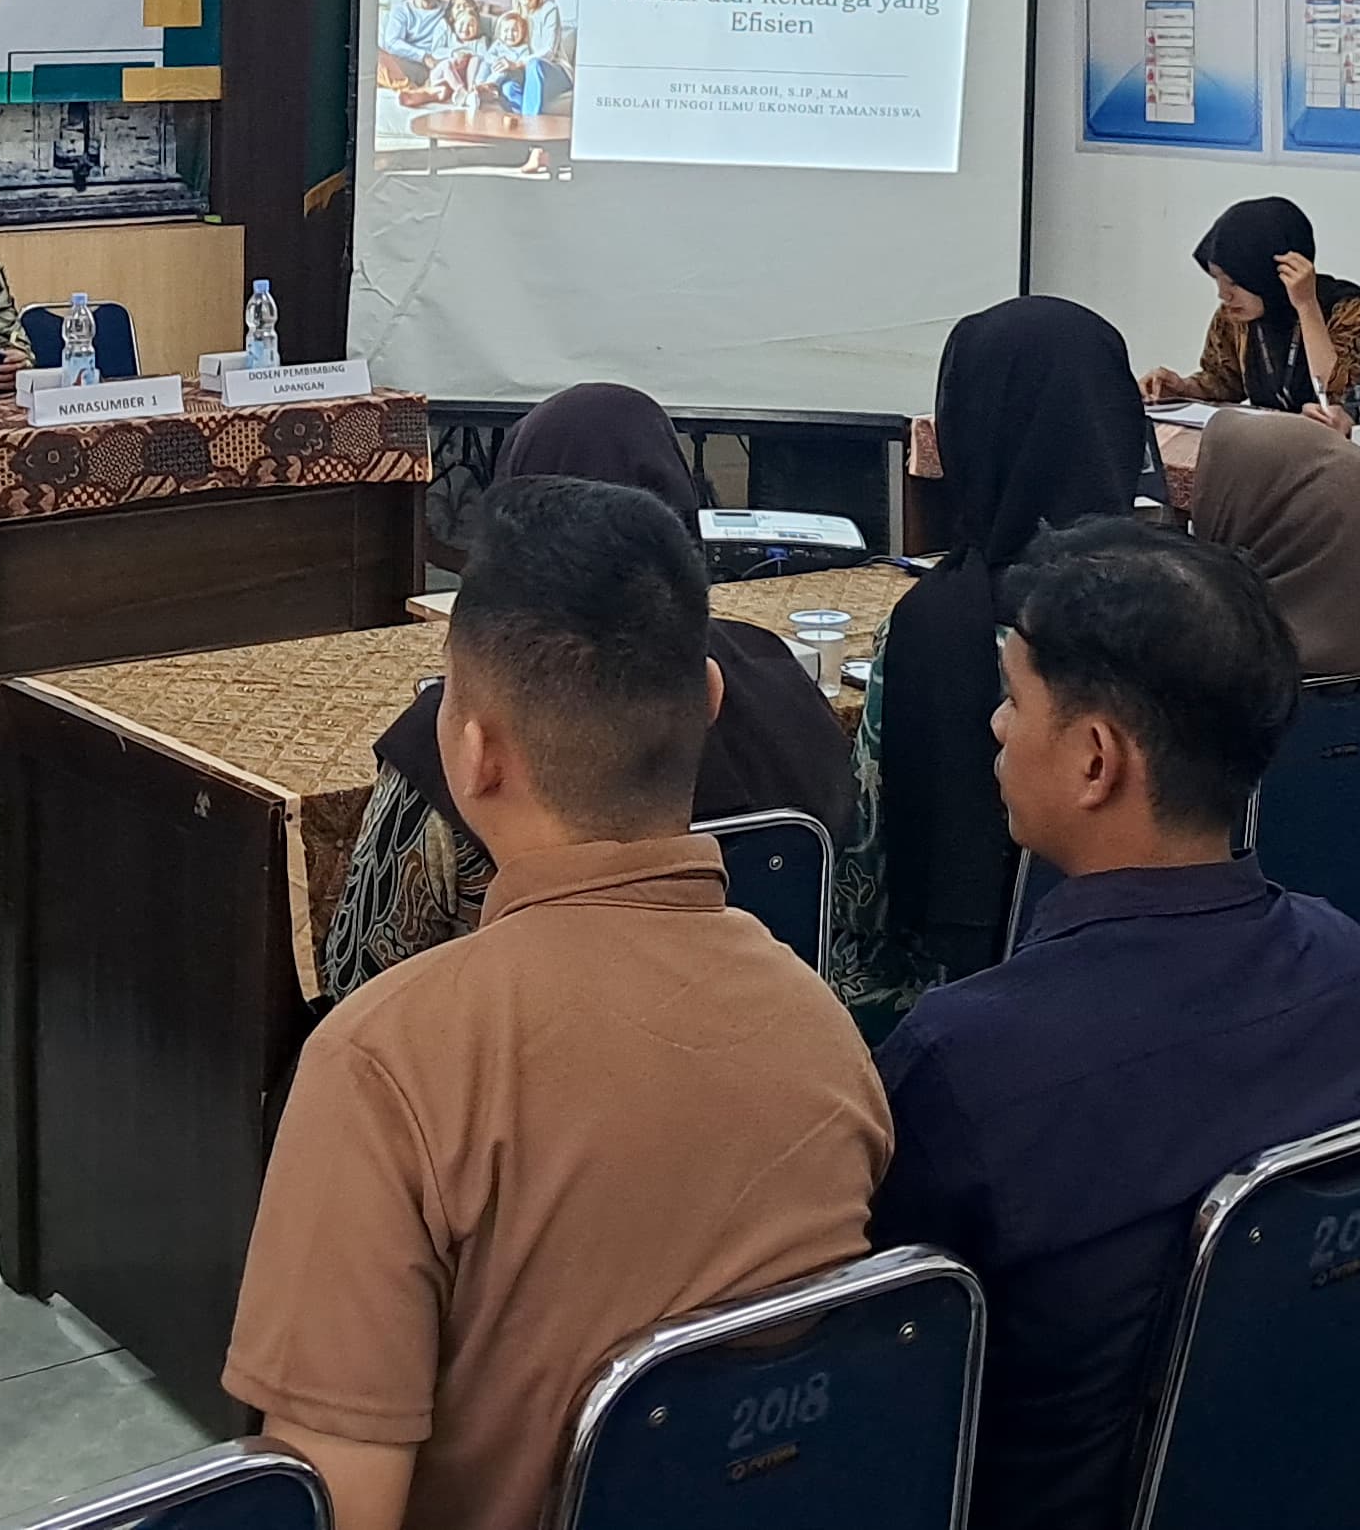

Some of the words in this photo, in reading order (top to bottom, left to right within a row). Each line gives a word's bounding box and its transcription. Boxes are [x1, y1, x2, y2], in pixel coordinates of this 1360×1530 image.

[730, 11, 814, 35] Efisien
[669, 83, 697, 94] SITI
[700, 83, 783, 98] MAESAROH,
[595, 97, 661, 110] SEKOLAH
[665, 99, 714, 111] TINGGI
[718, 100, 754, 112] ILMU
[758, 101, 824, 115] EKONOMI
[829, 104, 921, 118] TAMANSISWA
[248, 369, 281, 381] DOSEN
[283, 364, 345, 379] PEMBIMBING
[274, 381, 325, 394] LAPANGAN
[58, 396, 145, 415] NARASUMBER
[151, 395, 158, 406] 1
[727, 1372, 830, 1450] 2018
